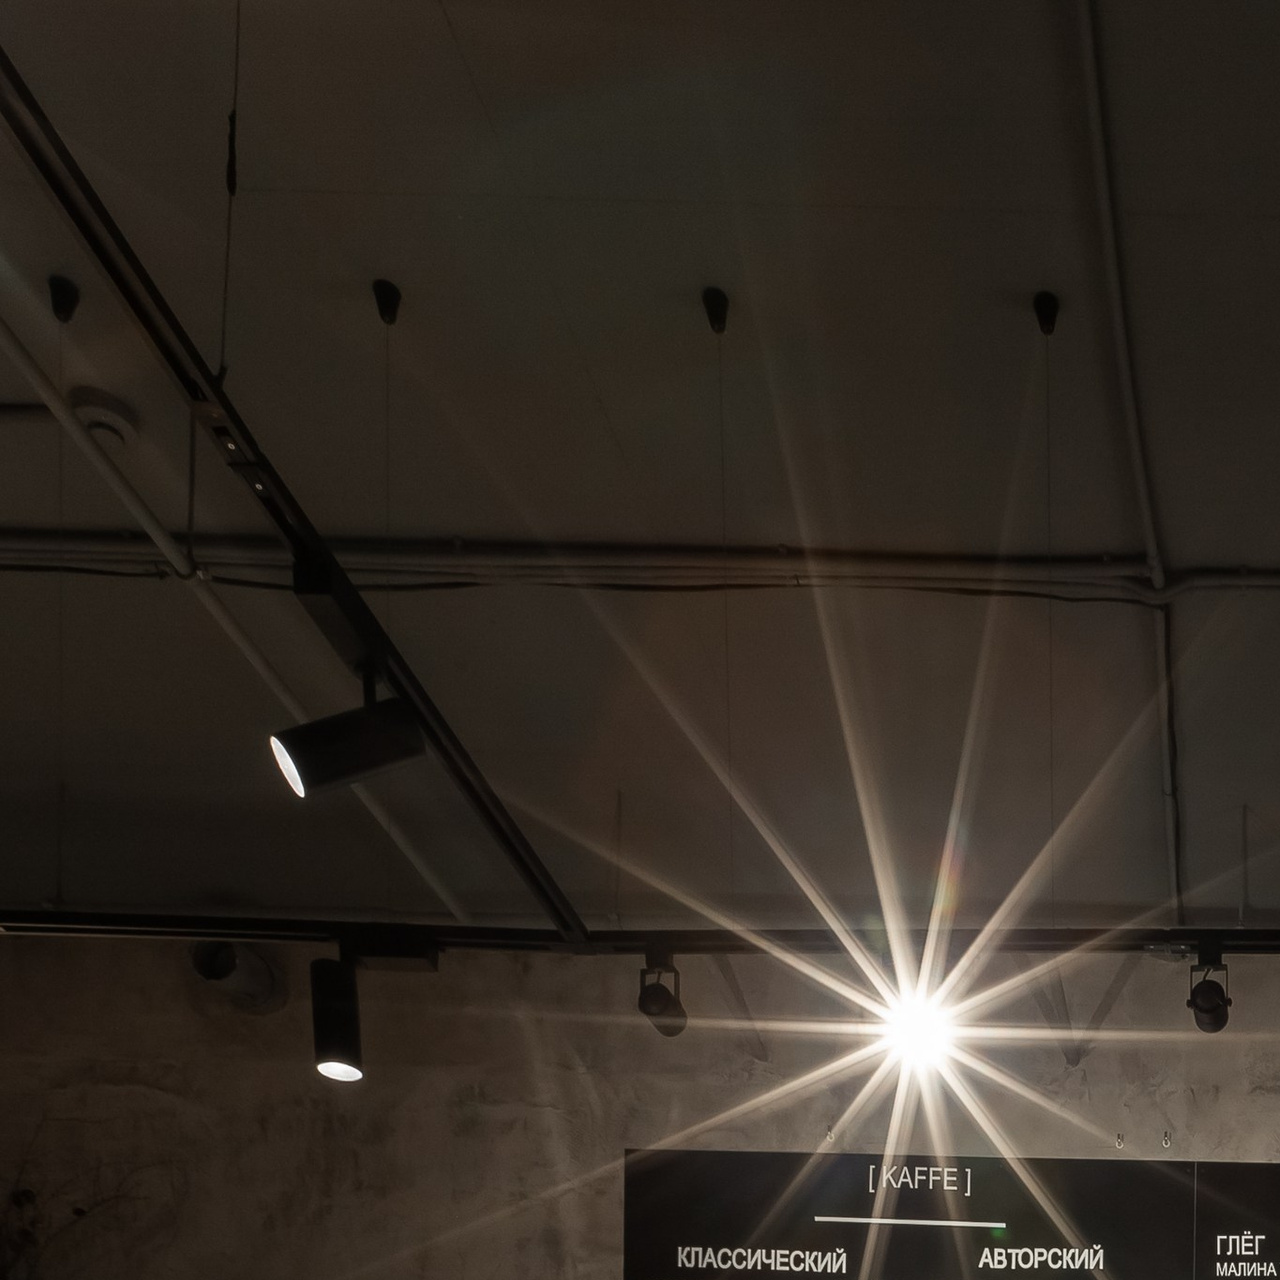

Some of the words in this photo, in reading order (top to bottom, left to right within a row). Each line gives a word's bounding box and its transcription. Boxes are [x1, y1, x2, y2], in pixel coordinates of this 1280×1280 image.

[1217, 1231, 1265, 1255] ГЛЁГ
[677, 1246, 847, 1273] КЛАССИЧЕСКИЙ
[979, 1245, 1104, 1269] АВТОРСКИЙ
[1216, 1263, 1277, 1277] МАЛИНА
